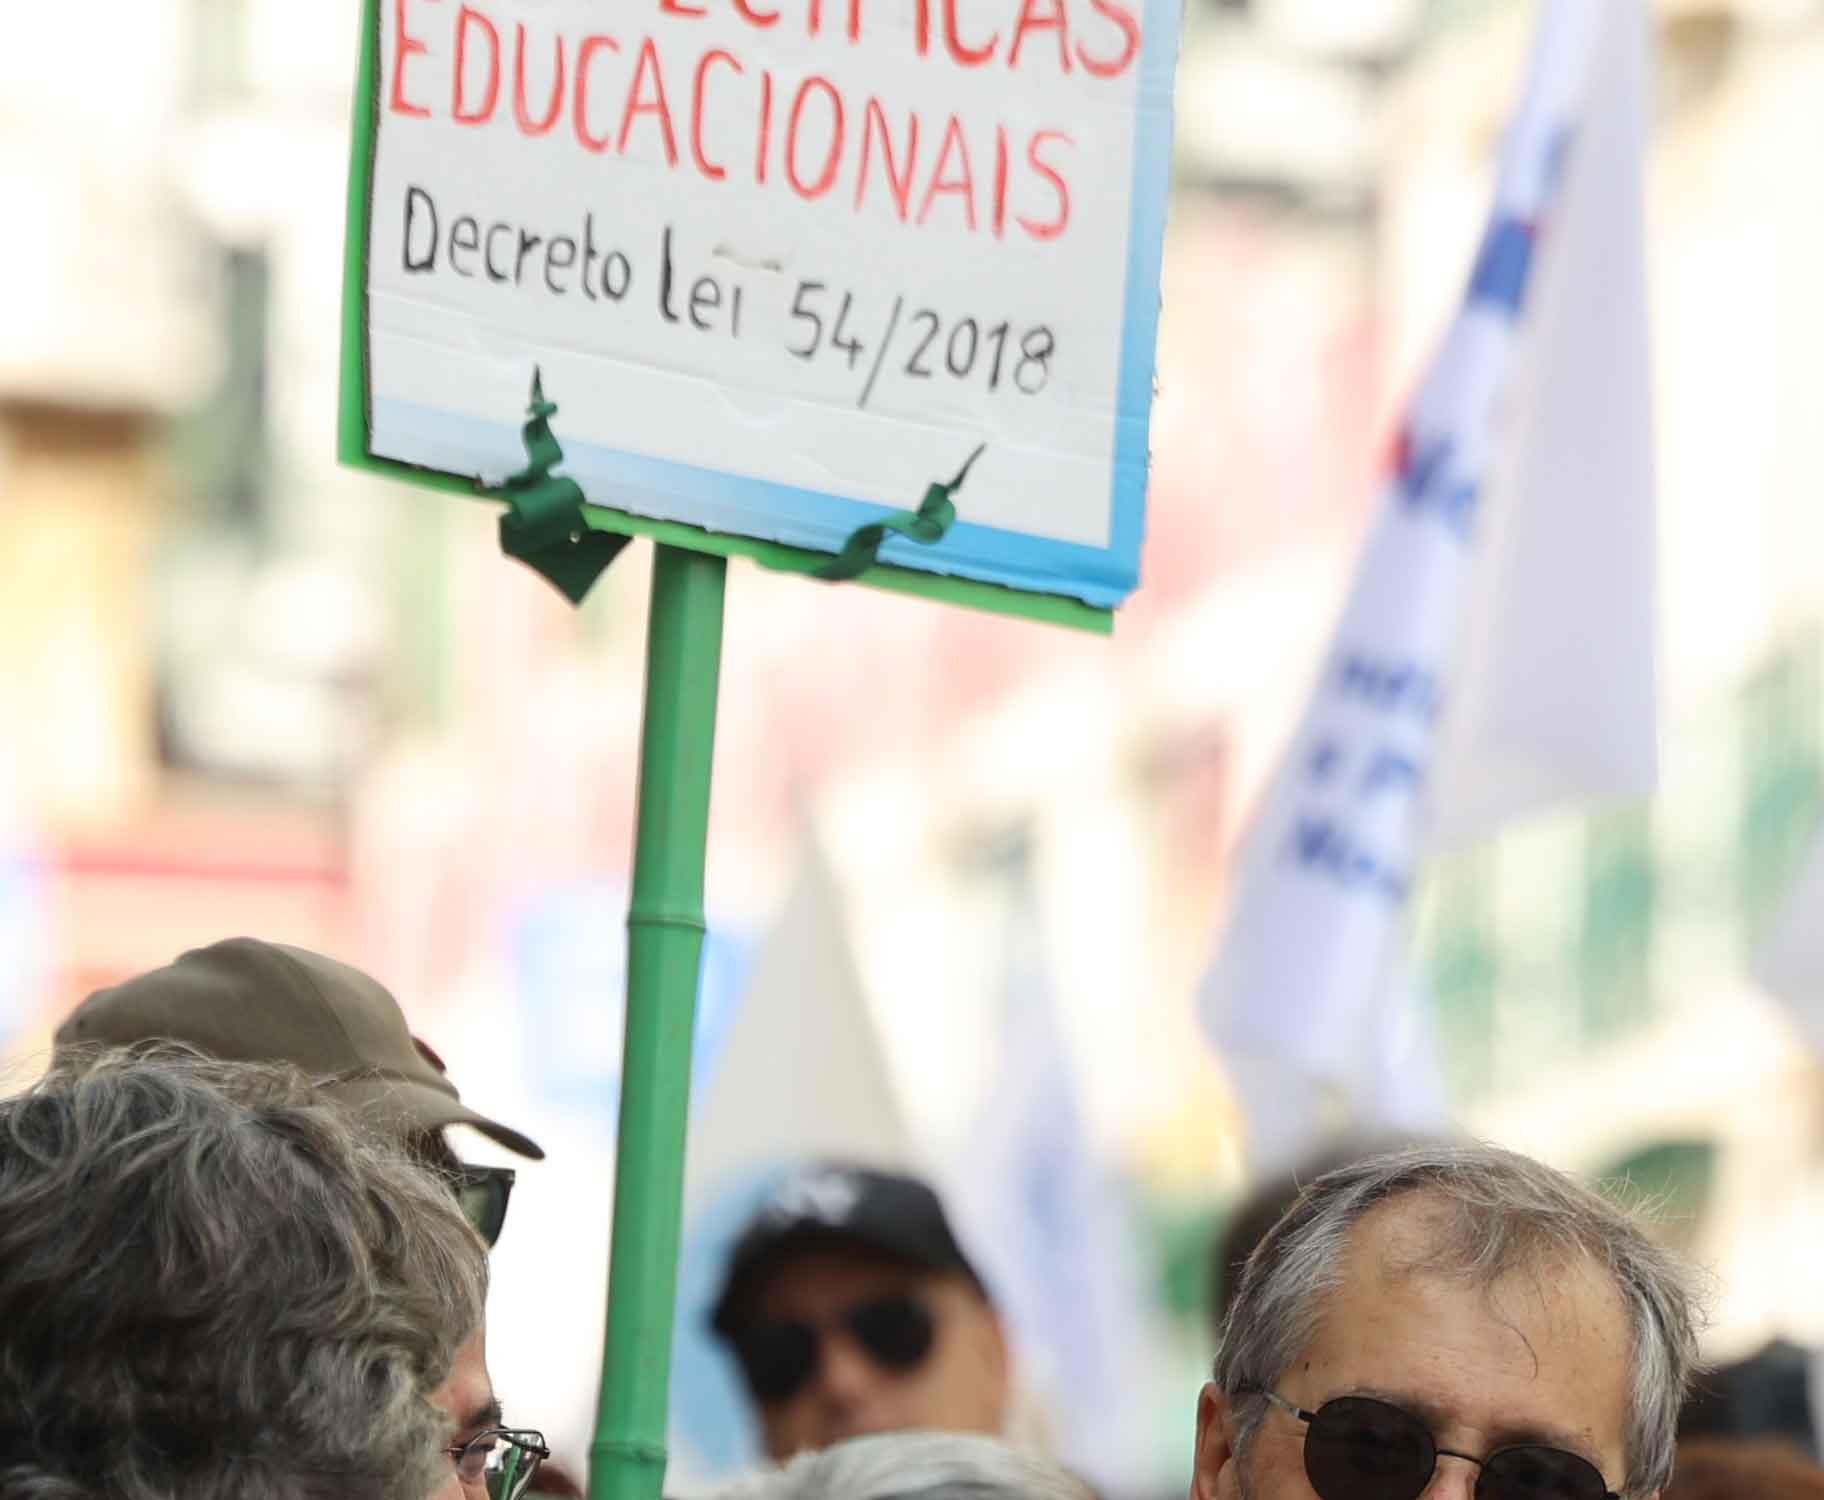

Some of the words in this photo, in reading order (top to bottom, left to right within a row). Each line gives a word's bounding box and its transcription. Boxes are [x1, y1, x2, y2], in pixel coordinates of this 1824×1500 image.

[387, 0, 1078, 241] EDUCACIONAIS
[401, 184, 632, 304] Decreto
[785, 280, 1057, 409] 54/2018
